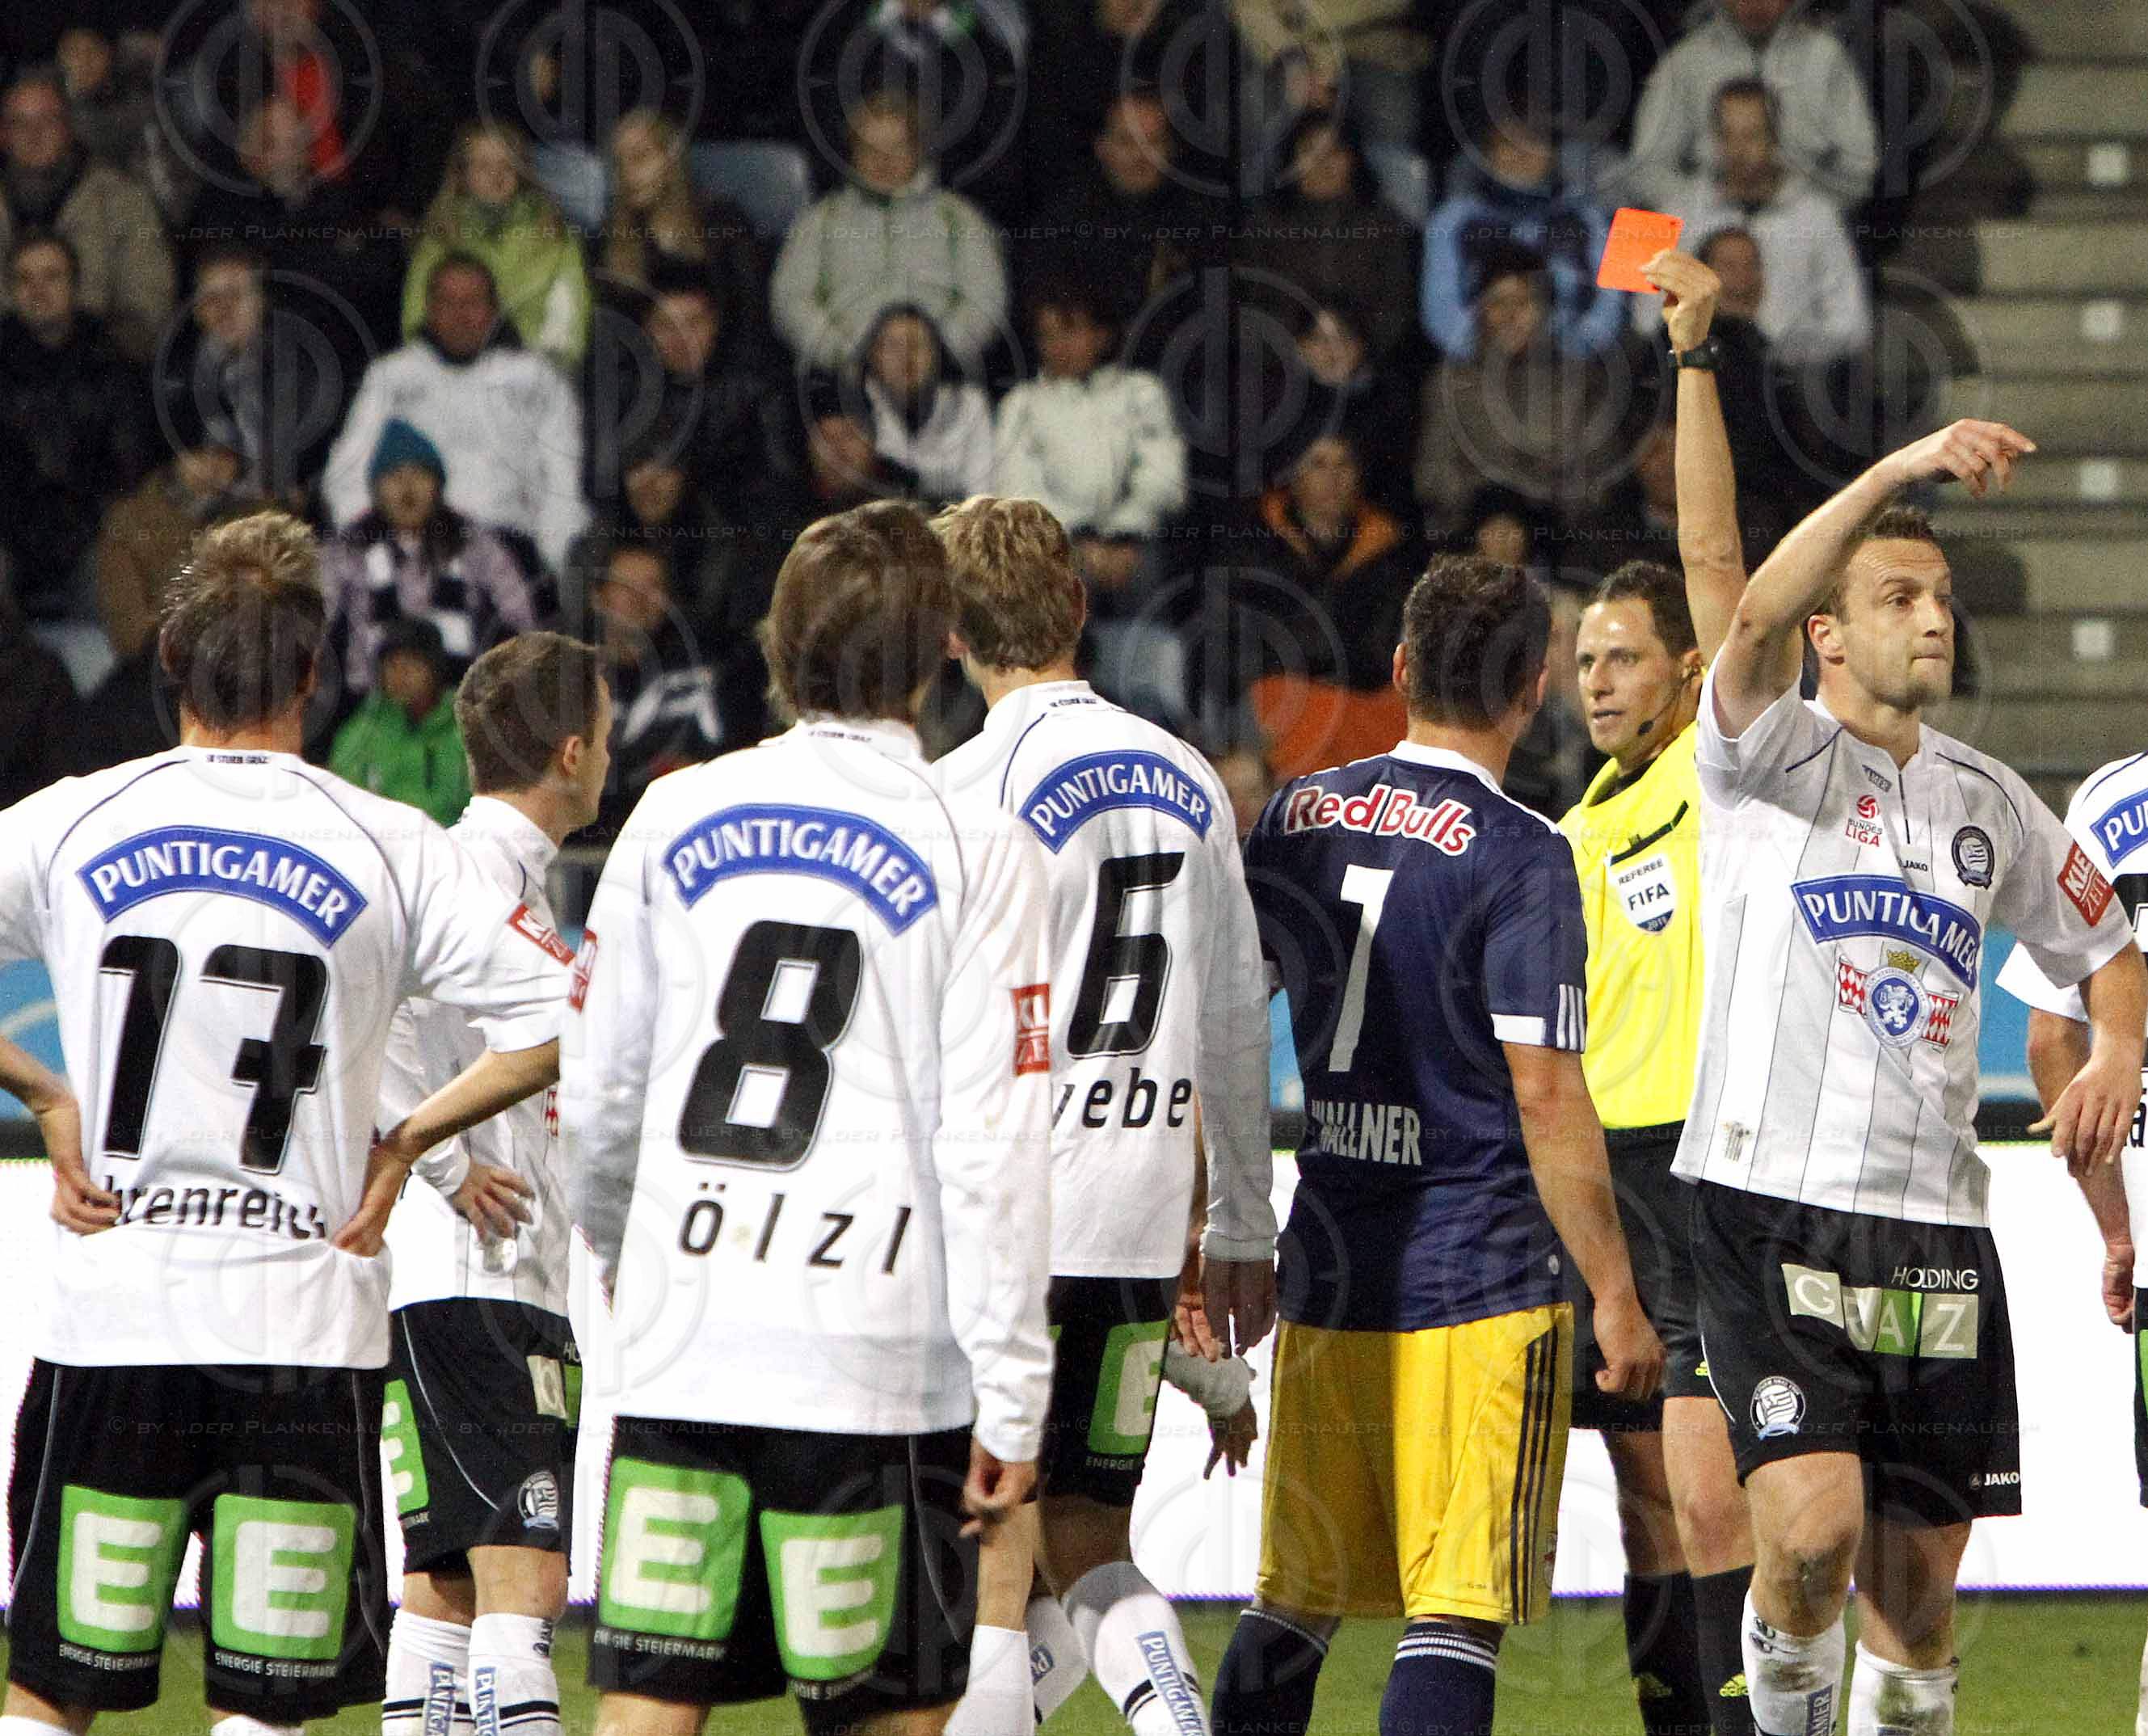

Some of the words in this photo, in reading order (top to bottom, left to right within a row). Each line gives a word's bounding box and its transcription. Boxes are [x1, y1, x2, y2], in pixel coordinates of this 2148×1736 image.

[1030, 763, 1207, 837] PUNTIGAMER
[1845, 825, 1880, 848] LIGA
[90, 840, 351, 928] PUNTIGAMER
[673, 820, 928, 921] PUNTIGAMER
[1618, 857, 1664, 886] REFEREE
[1628, 883, 1670, 911] FIFA
[1904, 860, 1928, 872] JAKO
[1067, 852, 1186, 1059] 6
[1329, 864, 1394, 1072] 7
[99, 934, 330, 1175] 17
[679, 920, 864, 1172] 8
[1891, 1266, 1978, 1290] HOLDING
[1984, 1472, 2020, 1486] JAKO
